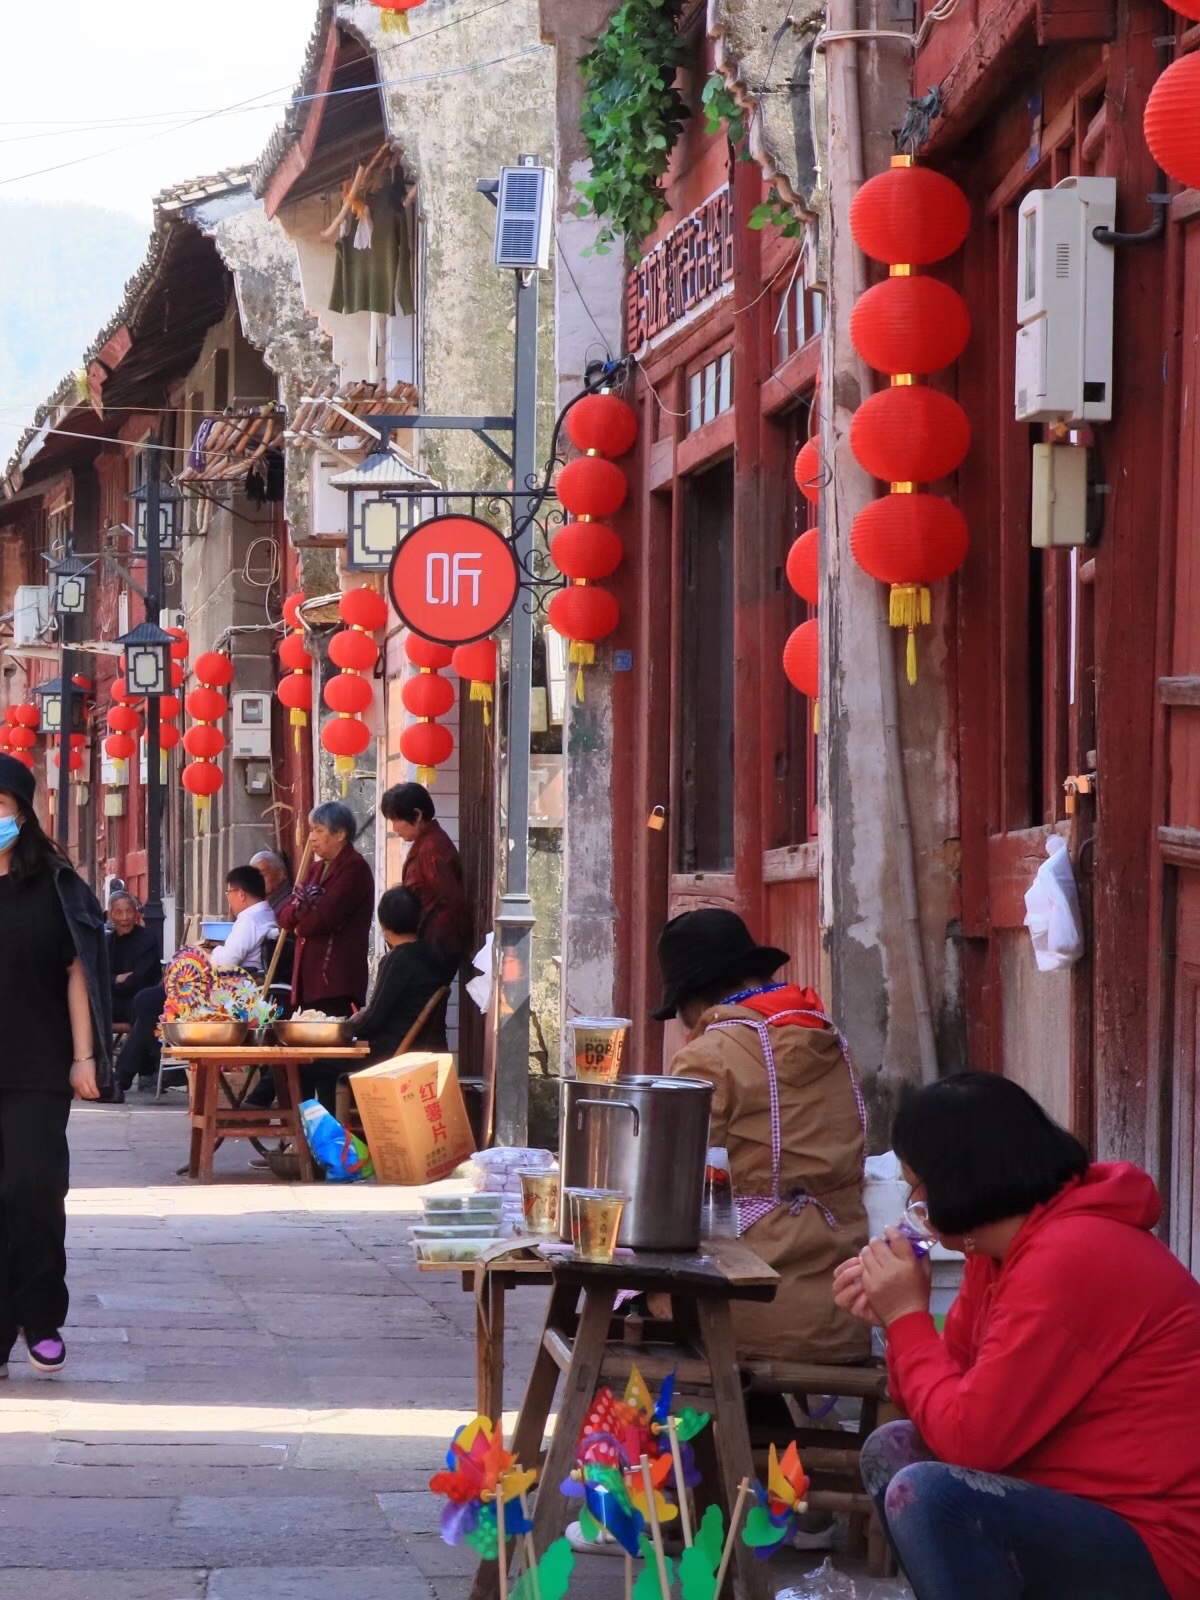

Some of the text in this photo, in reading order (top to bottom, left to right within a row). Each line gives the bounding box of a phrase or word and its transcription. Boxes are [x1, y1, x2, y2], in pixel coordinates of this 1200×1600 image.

[425, 552, 482, 607] 听
[585, 1043, 612, 1055] POP
[585, 1054, 604, 1065] UP
[420, 1082, 447, 1144] 红薯片
